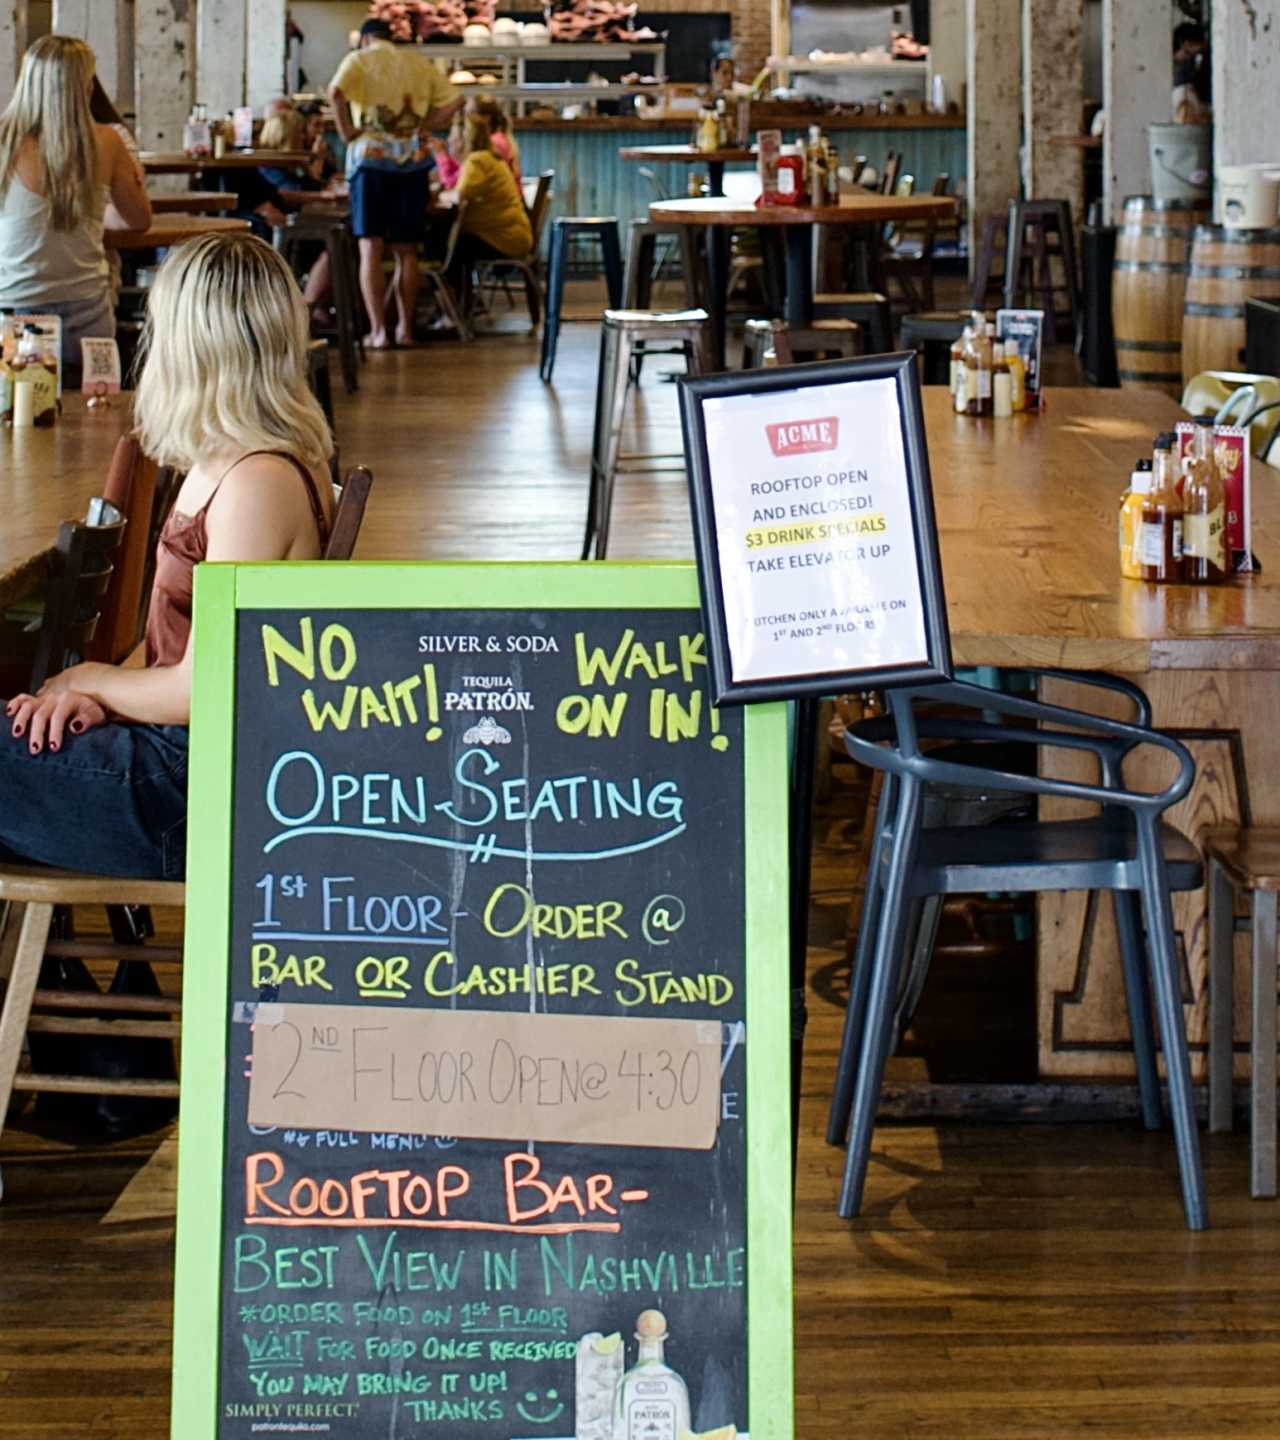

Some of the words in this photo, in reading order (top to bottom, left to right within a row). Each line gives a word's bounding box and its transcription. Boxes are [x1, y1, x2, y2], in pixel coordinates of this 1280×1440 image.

[776, 421, 833, 449] ACME
[751, 475, 822, 496] ROOFTOP
[826, 469, 869, 486] OPEN
[752, 505, 786, 522] AND
[790, 495, 873, 518] ENCLOSED!
[745, 533, 763, 549] $3
[767, 526, 815, 545] DRINK
[747, 556, 785, 574] TAKE
[870, 544, 891, 559] UP
[799, 608, 827, 622] ONLY
[889, 599, 907, 611] ON
[418, 636, 482, 653] SILVER
[486, 636, 501, 653] &
[508, 635, 559, 653] SODA
[790, 627, 814, 639] AND
[261, 616, 358, 687] NO
[574, 628, 708, 687] WALK
[462, 675, 513, 688] TEQUILA
[301, 663, 443, 742] WAIT!
[555, 691, 628, 739] ON
[265, 750, 426, 826] OPEN
[434, 748, 686, 827] SEATING
[252, 873, 308, 927] 1st
[483, 883, 629, 940] ORDER
[641, 893, 686, 946] @
[251, 943, 334, 991] BAR
[354, 956, 412, 991] OR
[424, 951, 602, 998] CASHIER
[614, 958, 735, 1007] STAND
[271, 1021, 341, 1100] 2ND
[352, 1026, 478, 1105] FLOOR
[616, 1048, 702, 1112] 4:30
[315, 1130, 360, 1146] FULL
[244, 1151, 470, 1219] ROOFTOP
[232, 1233, 340, 1294] BEST
[355, 1230, 465, 1293] VIEW
[482, 1247, 519, 1292] IN
[538, 1232, 746, 1297] NASHVILLE
[353, 1301, 416, 1327] FOOD
[421, 1305, 453, 1327] ON
[498, 1304, 568, 1329] FLOOR
[242, 1329, 311, 1359] WAIT
[316, 1336, 357, 1361] FOR
[365, 1337, 417, 1360] FOOD
[422, 1336, 484, 1360] ONCE
[489, 1340, 578, 1362] RECEIVED
[249, 1371, 295, 1397] YOU
[302, 1372, 350, 1396] MAY
[356, 1370, 432, 1396] BRING
[441, 1373, 461, 1395] IT
[469, 1370, 509, 1395] UP!
[225, 1403, 282, 1418] SIMPLY
[402, 1396, 506, 1423] THANKS
[251, 1422, 330, 1433] patrontequila.com
